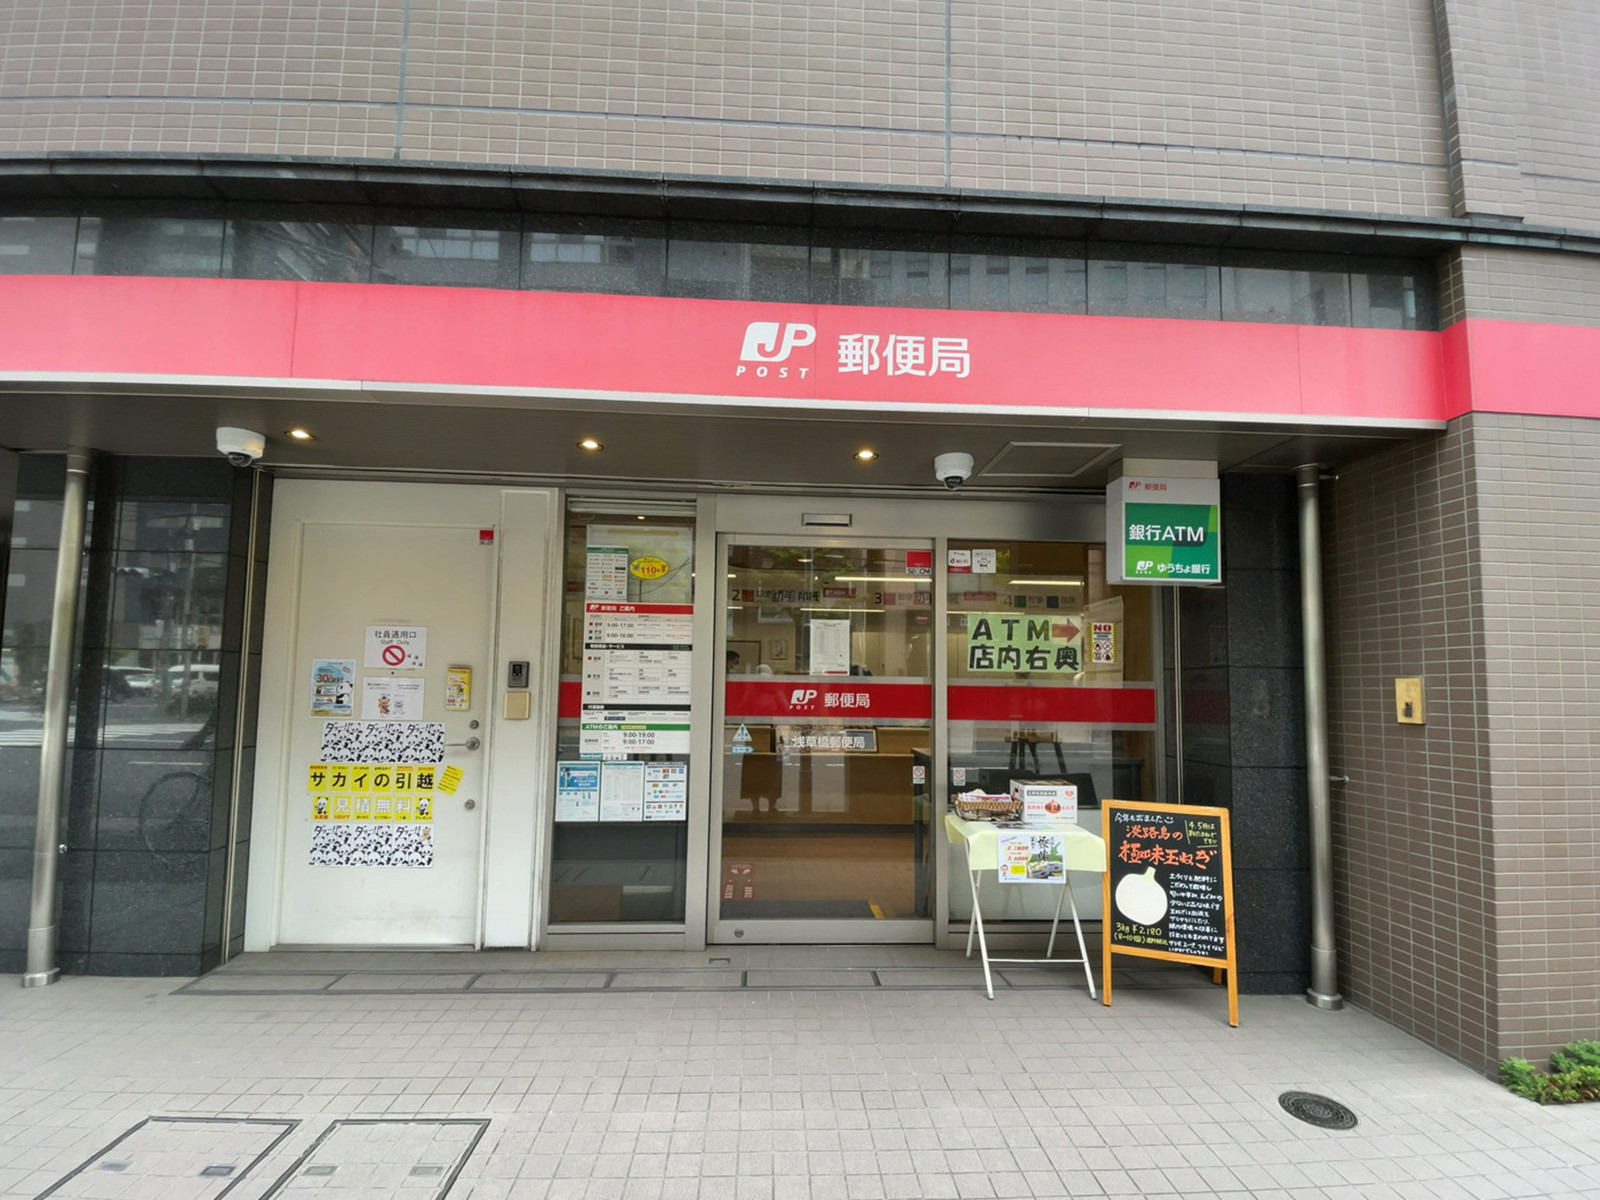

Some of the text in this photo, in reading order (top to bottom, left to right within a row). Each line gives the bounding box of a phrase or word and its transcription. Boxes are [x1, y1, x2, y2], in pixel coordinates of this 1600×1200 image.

[740, 321, 971, 378] JP 郵便局
[736, 365, 810, 379] POST
[1128, 524, 1204, 542] 銀行ATM
[1156, 563, 1211, 574] ゆうちょ銀行
[731, 589, 740, 602] 2
[874, 592, 882, 604] 3
[374, 630, 417, 639] 社員通用口
[971, 618, 1050, 641] ATM
[1093, 624, 1112, 632] NO
[969, 643, 1080, 671] 店内右奥
[824, 692, 871, 709] 郵便局
[792, 736, 866, 749] 浅草橋郵便局
[311, 772, 434, 790] サカイの引越
[337, 798, 411, 814] 見積無料
[1125, 825, 1183, 840] 淡路島の
[1118, 840, 1218, 870] 極味玉ねぎ
[1116, 922, 1130, 933] 3kg
